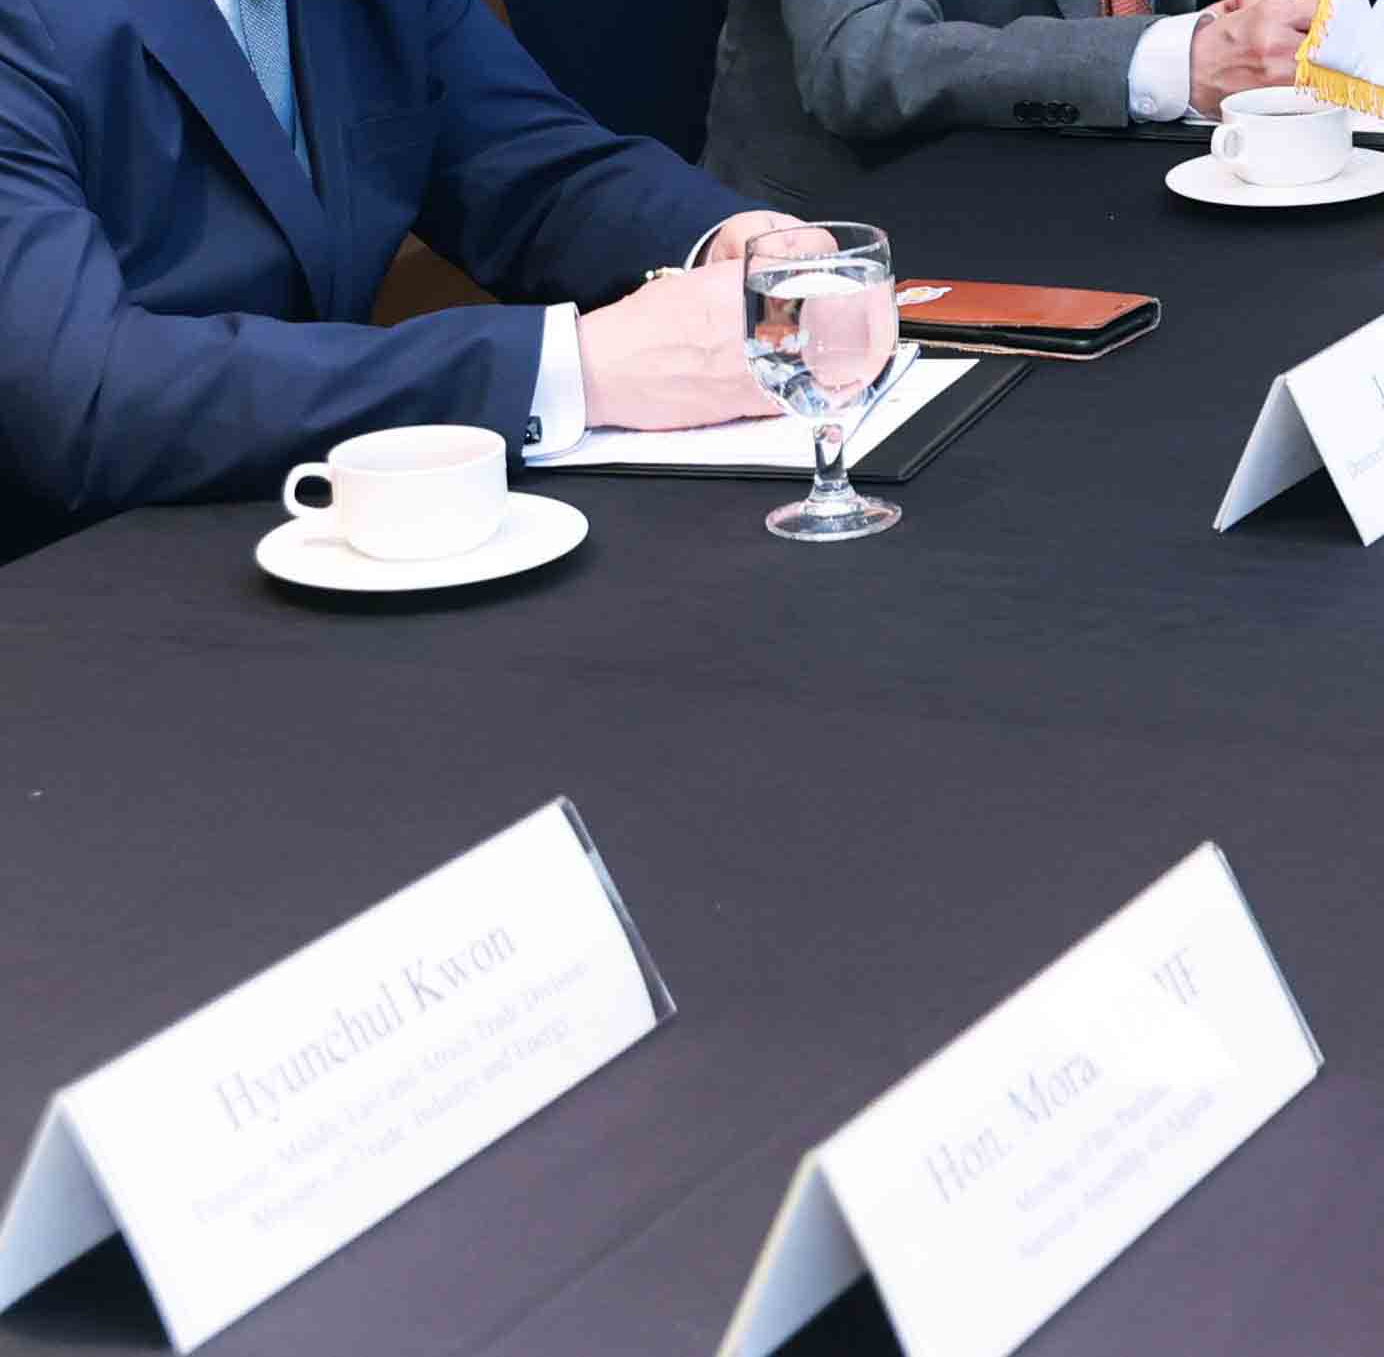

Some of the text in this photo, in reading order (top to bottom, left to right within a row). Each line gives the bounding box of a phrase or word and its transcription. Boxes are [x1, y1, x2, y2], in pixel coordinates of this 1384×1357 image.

[212, 926, 516, 1132] Hyunchul Kwon
[924, 1127, 1013, 1204] Hon.
